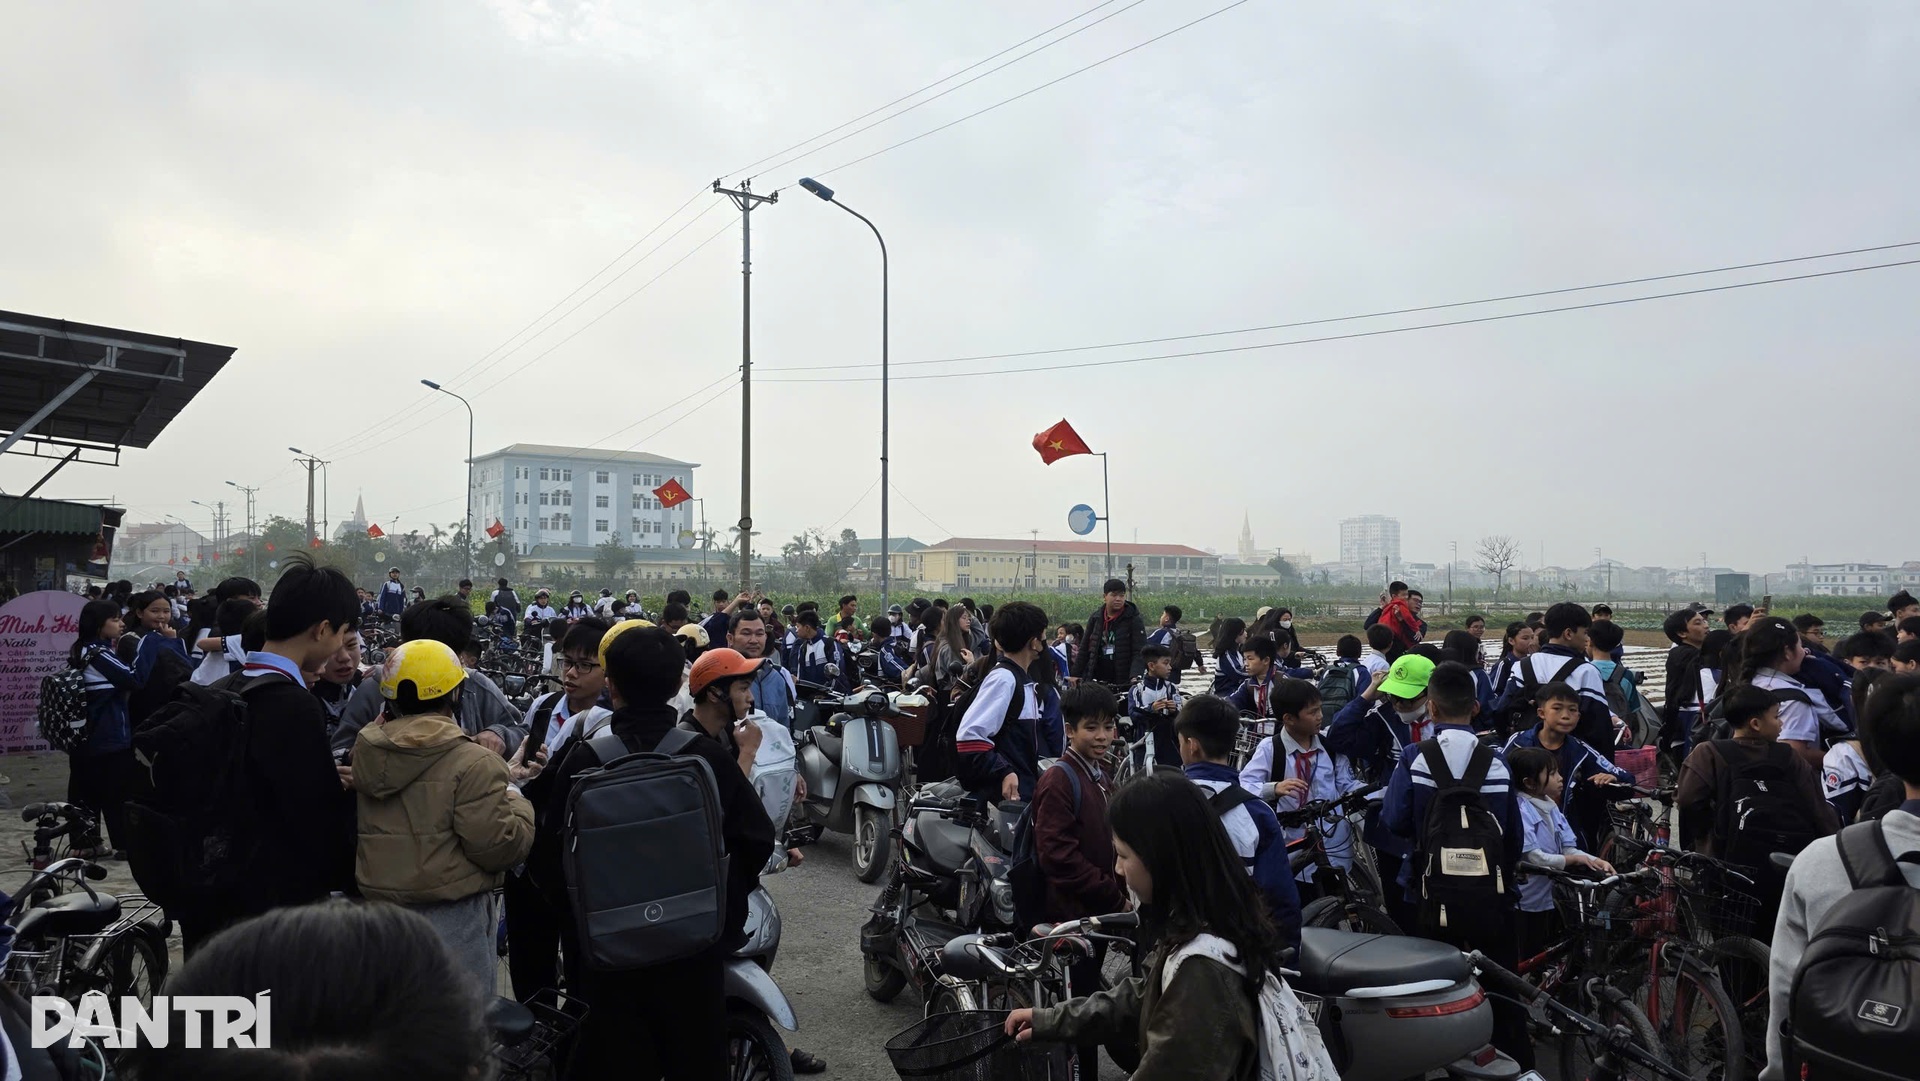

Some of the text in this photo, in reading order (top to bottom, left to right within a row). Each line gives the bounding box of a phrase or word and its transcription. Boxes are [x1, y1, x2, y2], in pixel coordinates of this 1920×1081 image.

[0, 614, 47, 634] Minh
[1, 638, 37, 648] Nails
[34, 664, 57, 673] sóc
